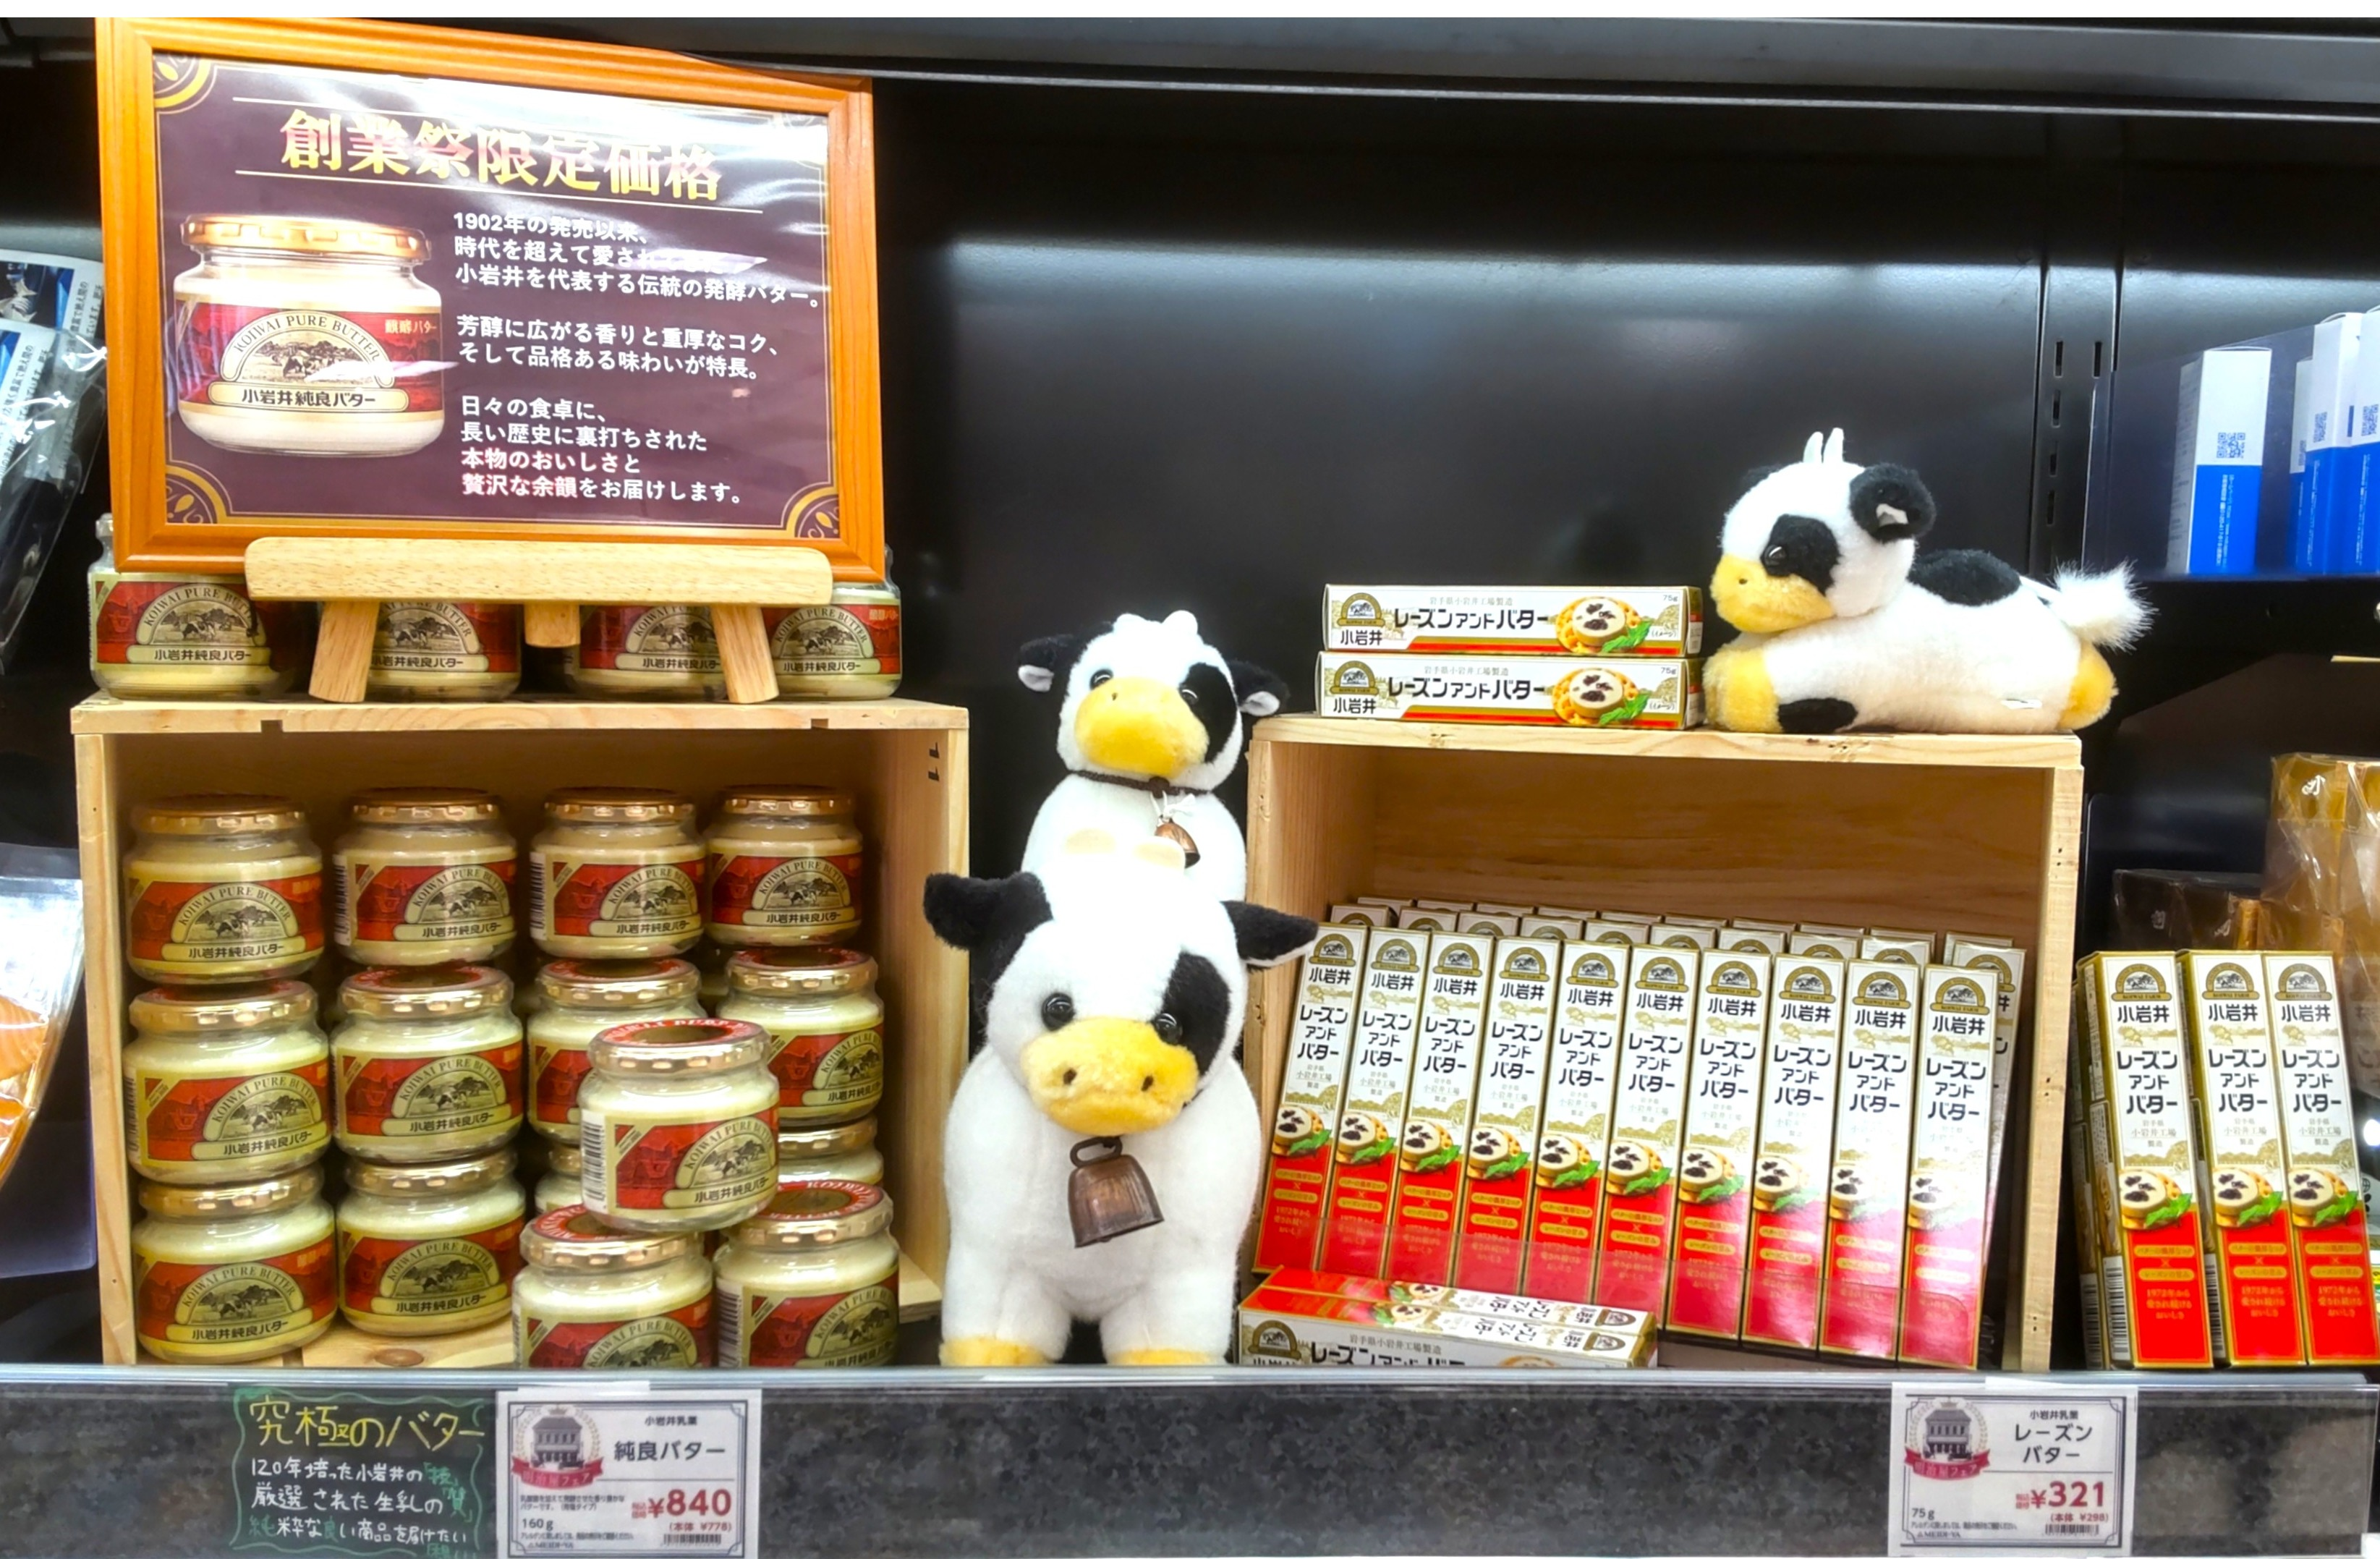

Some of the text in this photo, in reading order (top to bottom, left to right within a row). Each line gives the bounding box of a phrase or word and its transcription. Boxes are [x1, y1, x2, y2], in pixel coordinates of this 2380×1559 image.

[281, 109, 721, 200] 創業祭限定価格
[453, 212, 648, 244] 1902年の発売以来、
[455, 262, 818, 307] 小岩井を代表する伝統の発酵バター。
[234, 315, 380, 361] KOIWAI PURE BUTTER
[456, 314, 778, 355] 芳醇に広がる香りと重厚なコク、
[458, 343, 757, 380] そして品格ある味わいが特長。
[242, 388, 376, 407] 小岩井純良バター
[462, 396, 606, 422] 日々の食卓に、
[461, 422, 707, 452] 長い歴史に裏打ちされた
[462, 447, 640, 474] 本物のおいしさと
[462, 474, 740, 504] 贅沢な余韻をお届けします。
[144, 587, 221, 626] KOIWAI PURE
[807, 608, 836, 619] PURE
[838, 611, 868, 643] BUTTER
[1394, 608, 1548, 629] レーズンアンドバター
[1340, 629, 1382, 645] 小岩井
[155, 648, 251, 662] 小岩井純良バター
[783, 660, 862, 672] 小岩井純良バター
[1388, 676, 1544, 700] レーズンアンドバター
[1333, 697, 1376, 714] 小岩井
[608, 867, 672, 905] KOIWAI PURE
[758, 860, 820, 895] KOIWAI PURE
[413, 869, 480, 907] KOIWAI PURE
[179, 886, 291, 925] KOIWAI PURE BUTTER
[616, 919, 689, 934] 小岩井純良バター
[767, 912, 841, 925] 小岩井純良バター
[422, 922, 501, 938] 小岩井純良バター
[190, 942, 284, 959] 小岩井純良バター
[1309, 967, 1351, 985] 小岩井
[1371, 972, 1414, 991] 小岩井
[1433, 977, 1478, 996] 小岩井
[1500, 982, 1545, 1001] 小岩井
[1567, 987, 1614, 1007] 小岩井
[1636, 993, 1684, 1012] 小岩井
[1707, 997, 1757, 1017] 小岩井
[1299, 1004, 1348, 1025] レーズン
[1362, 1011, 1412, 1032] レーズン
[1781, 1003, 1832, 1023] 小岩井
[1855, 1008, 1906, 1029] 小岩井
[2117, 1004, 2170, 1024] 小岩井
[2208, 1003, 2258, 1022] 小岩井
[2281, 1004, 2332, 1023] 小岩井
[1305, 1025, 1338, 1042] アンド
[1425, 1016, 1476, 1036] レーズン
[1491, 1021, 1543, 1042] レーズン
[1932, 1015, 1985, 1036] 小岩井
[1368, 1032, 1401, 1048] アンド
[1430, 1037, 1464, 1054] アンド
[1559, 1028, 1612, 1049] レーズン
[1628, 1032, 1683, 1055] レーズン
[1297, 1042, 1339, 1061] バター
[1360, 1049, 1403, 1068] バター
[1497, 1043, 1532, 1060] アンド
[1565, 1050, 1601, 1066] アンド
[1700, 1038, 1756, 1060] レーズン
[1774, 1045, 1831, 1067] レーズン
[2208, 1048, 2267, 1068] レーズン
[2281, 1049, 2340, 1069] レーズン
[1423, 1055, 1467, 1074] バター
[1635, 1055, 1672, 1072] アンド
[1707, 1061, 1745, 1078] アンド
[1848, 1051, 1907, 1074] レーズン
[1926, 1058, 1986, 1081] レーズン
[2117, 1050, 2178, 1070] レーズン
[400, 1068, 437, 1100] KOIWAI
[439, 1058, 469, 1070] PURE
[1490, 1061, 1535, 1080] バター
[1558, 1069, 1604, 1087] バター
[1782, 1067, 1819, 1085] アンド
[2220, 1073, 2260, 1088] アンド
[1628, 1073, 1675, 1092] バター
[1700, 1079, 1748, 1099] バター
[1856, 1074, 1895, 1092] アンド
[1934, 1082, 1975, 1099] アンド
[2128, 1074, 2169, 1090] アンド
[2294, 1073, 2334, 1089] アンド
[212, 1085, 250, 1123] KOIWAI
[255, 1076, 286, 1088] PURE
[1775, 1087, 1824, 1106] バター
[1849, 1094, 1900, 1113] バター
[2126, 1095, 2178, 1115] バター
[2218, 1093, 2268, 1113] バター
[2292, 1094, 2342, 1113] バター
[1928, 1101, 1980, 1121] バター
[410, 1113, 494, 1132] 小岩井純良バター
[223, 1131, 312, 1155] 小岩井純良バター
[684, 1121, 751, 1169] KOIWAI PURE
[694, 1177, 769, 1203] 小岩井純良バター
[387, 1250, 417, 1282] KOIWAI
[420, 1241, 458, 1254] PURE
[182, 1266, 296, 1308] KOIWAI PURE BUTTER
[396, 1293, 486, 1313] 小岩井純良バター
[192, 1320, 288, 1341] 小岩井純良バター
[629, 1320, 661, 1333] PURE
[250, 1395, 485, 1451] 究極のバター
[645, 1416, 697, 1427] 小岩井乳業
[2030, 1411, 2079, 1420] 小岩井乳業
[2015, 1424, 2093, 1443] レーズン
[613, 1440, 726, 1462] 純良バター
[2023, 1447, 2081, 1464] バター
[647, 1489, 731, 1518] ¥840
[2031, 1481, 2104, 1508] ¥321
